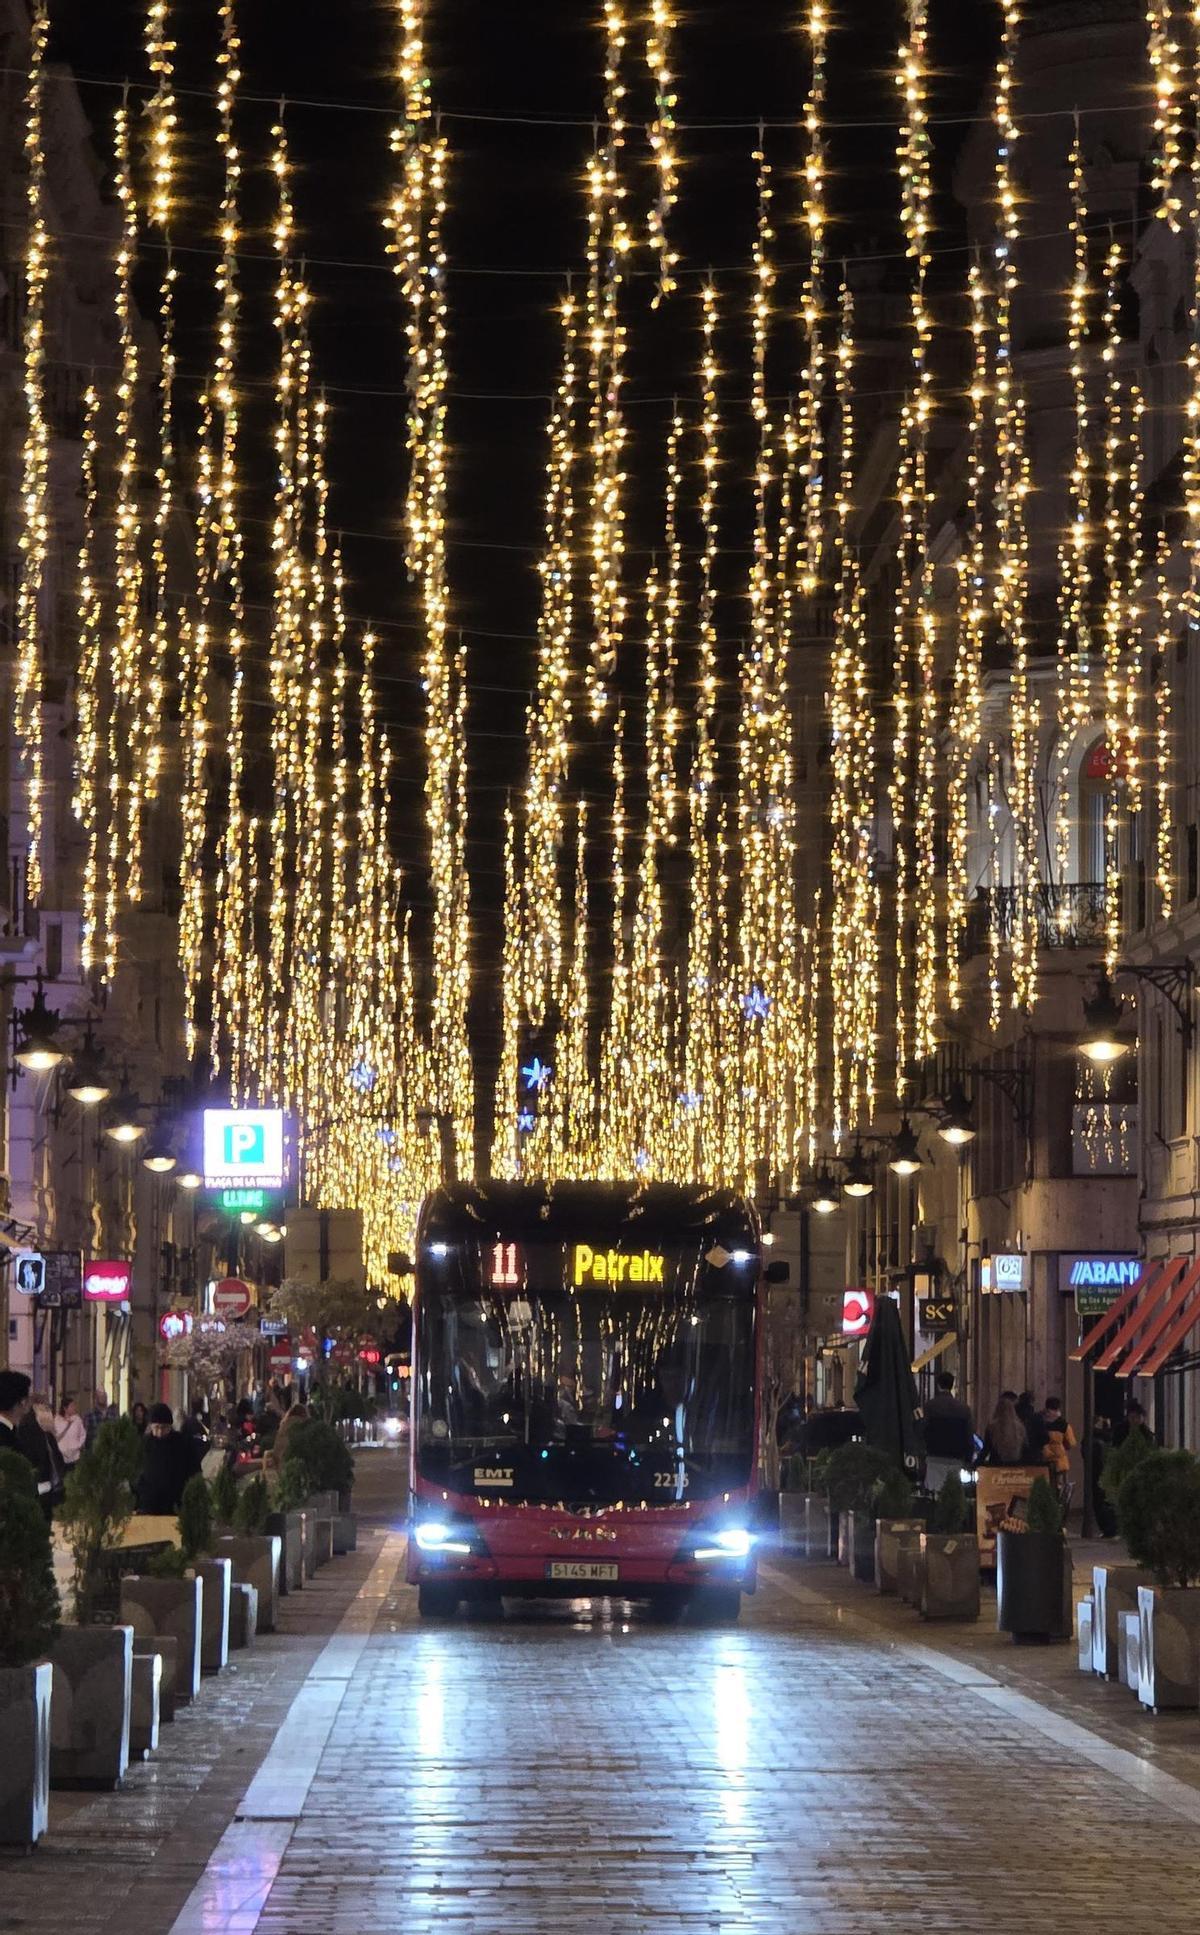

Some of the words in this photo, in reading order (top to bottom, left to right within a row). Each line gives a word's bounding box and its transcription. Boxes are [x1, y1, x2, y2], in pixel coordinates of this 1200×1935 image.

[232, 1126, 257, 1164] P
[492, 1243, 518, 1283] 11
[574, 1245, 664, 1285] Patraix
[474, 1468, 514, 1478] EMT
[554, 1564, 587, 1577] 5145
